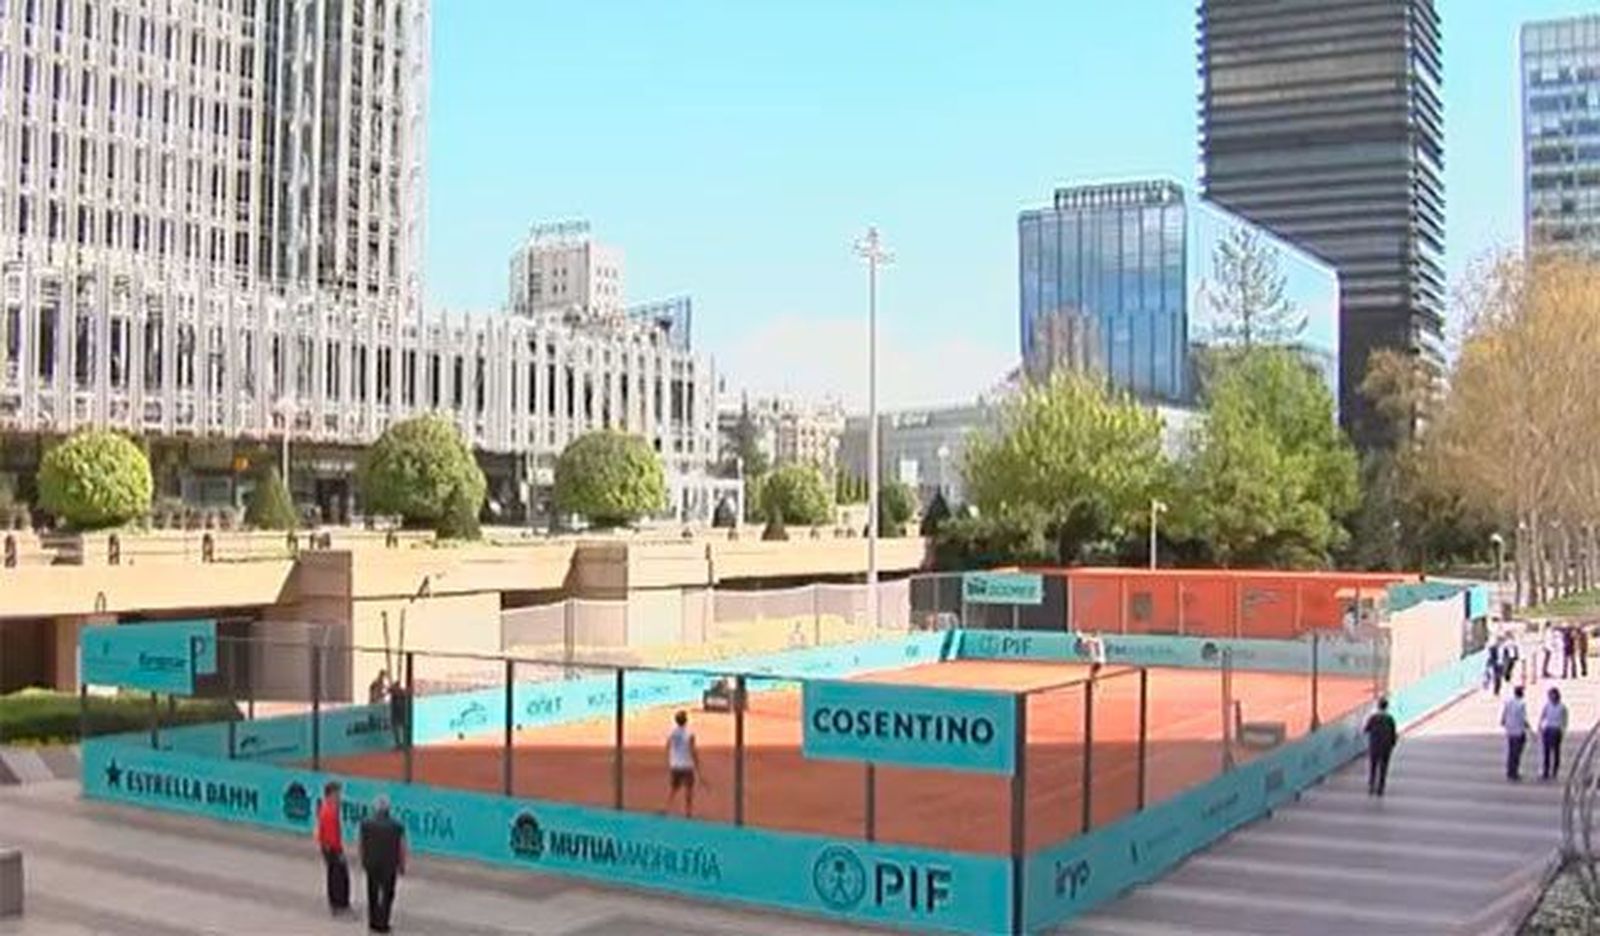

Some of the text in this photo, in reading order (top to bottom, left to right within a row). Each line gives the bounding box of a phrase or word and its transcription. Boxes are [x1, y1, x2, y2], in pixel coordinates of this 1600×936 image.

[813, 707, 995, 745] COSENTINO
[126, 769, 259, 815] ESTRELLA DAMM
[875, 861, 952, 914] PIF
